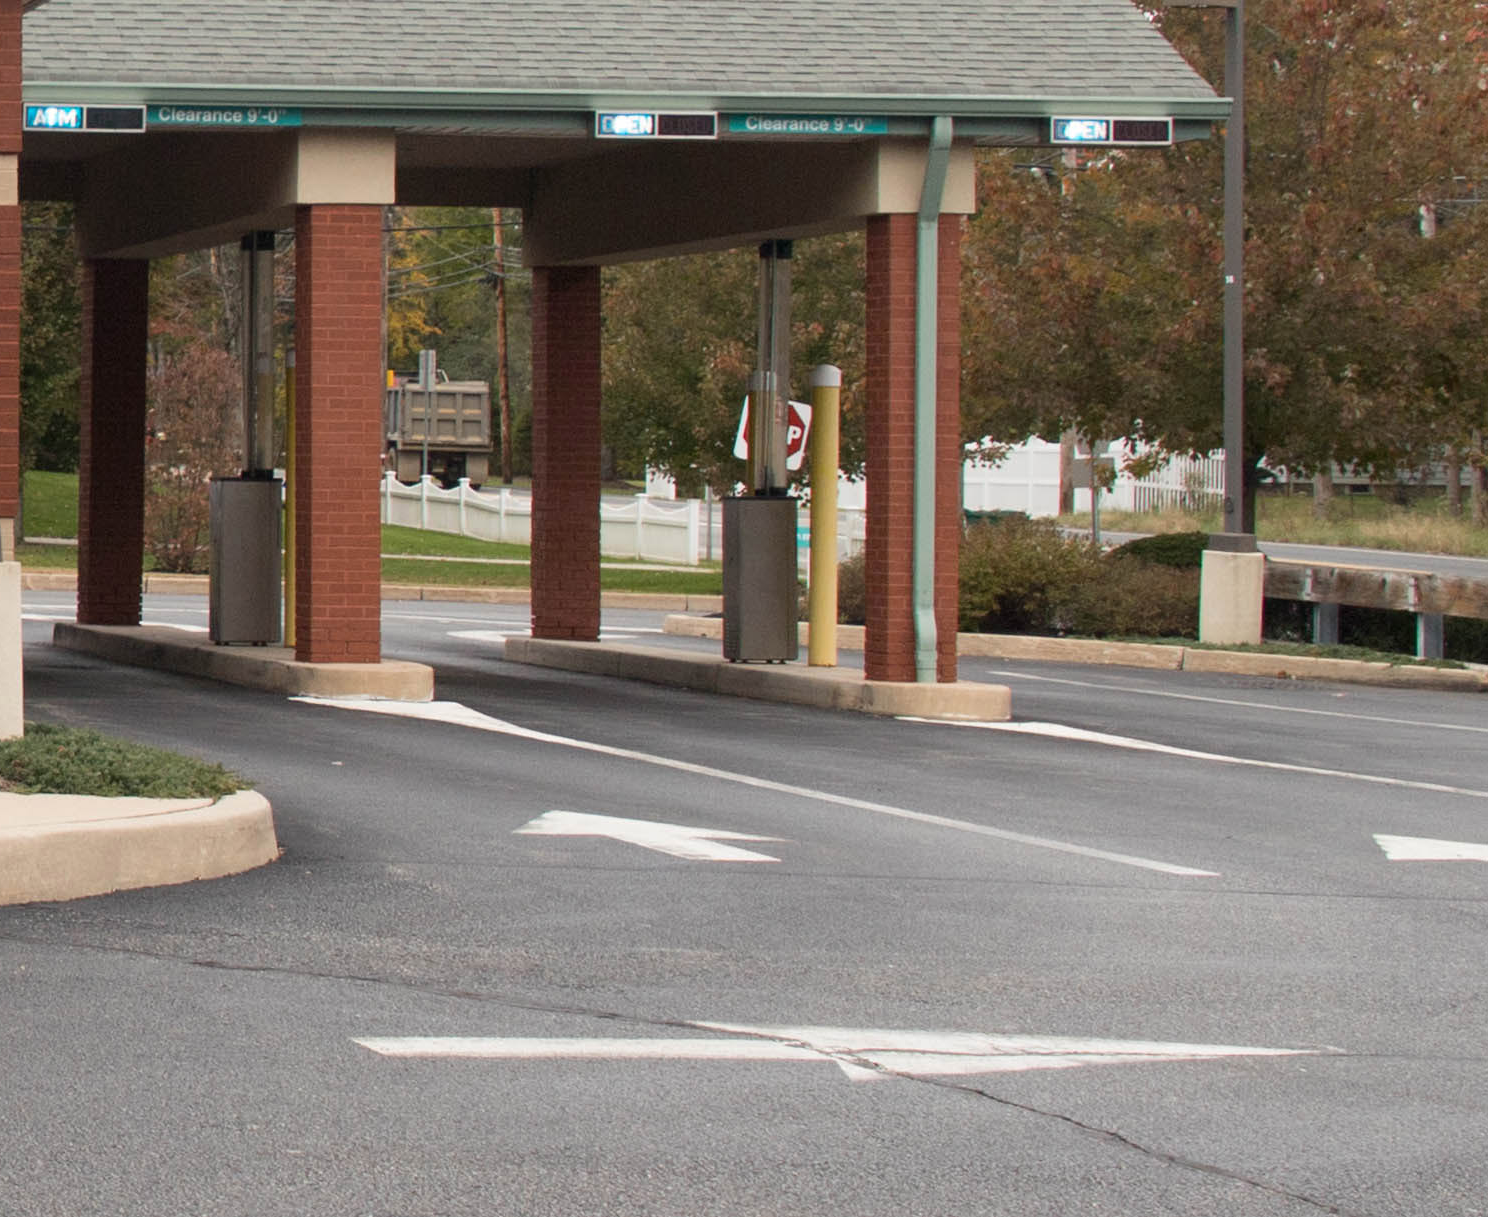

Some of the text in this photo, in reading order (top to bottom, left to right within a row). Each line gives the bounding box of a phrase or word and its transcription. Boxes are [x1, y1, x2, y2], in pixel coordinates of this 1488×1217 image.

[32, 107, 77, 127] ATM
[158, 106, 242, 123] Clearance
[744, 115, 829, 131] Clearance
[601, 115, 653, 134] OPEN
[1056, 121, 1108, 140] OPEN
